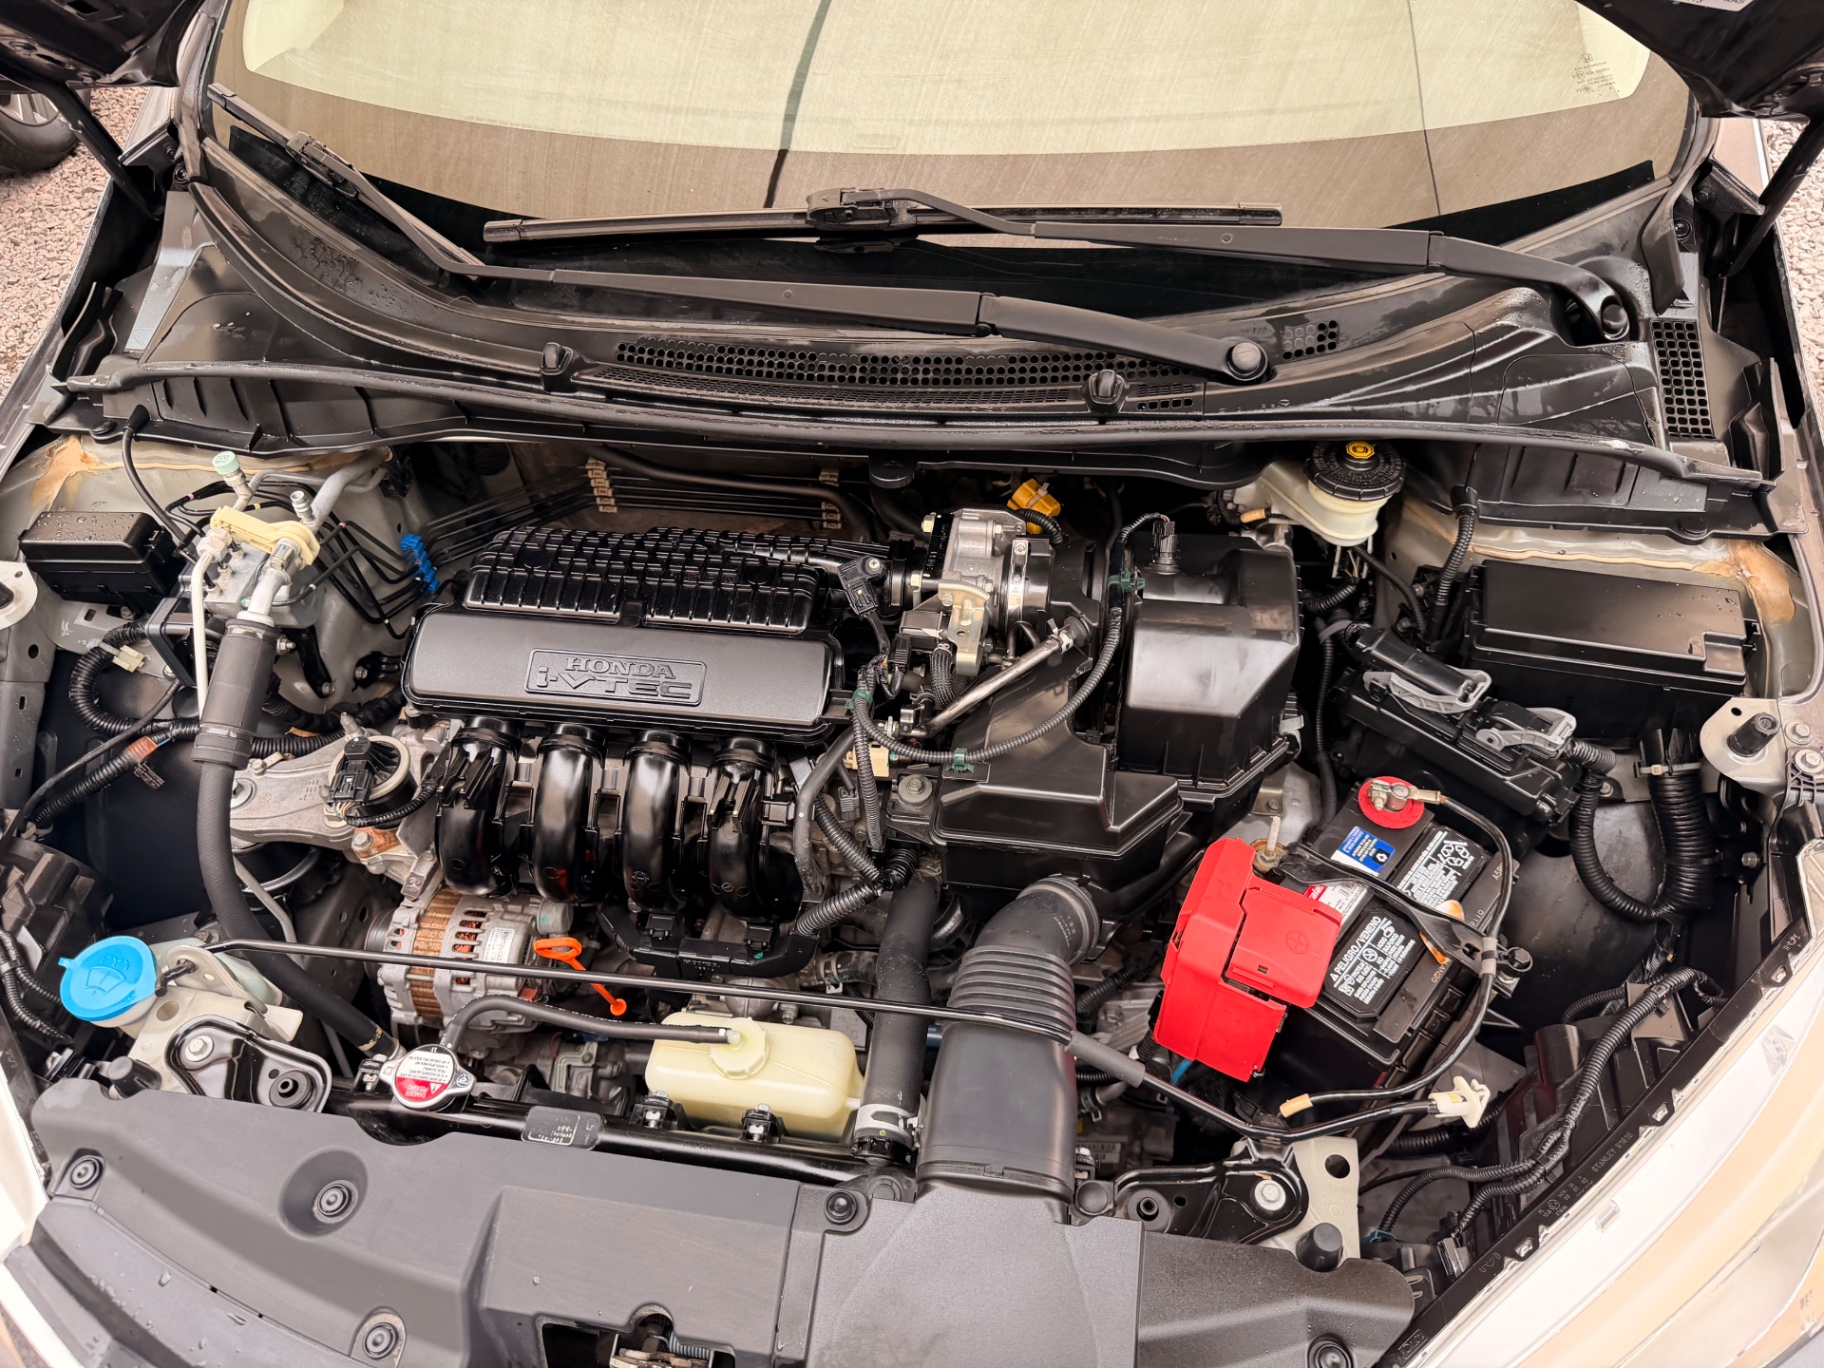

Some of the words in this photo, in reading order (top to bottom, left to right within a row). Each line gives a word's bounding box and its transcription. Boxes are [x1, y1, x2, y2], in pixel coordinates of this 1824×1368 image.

[564, 657, 676, 679] HONDA
[536, 666, 692, 699] i-VTEC
[1334, 915, 1381, 974] PELIGRO/VENENO
[404, 1089, 426, 1098] DANGER
[407, 1084, 428, 1092] PELIGRO
